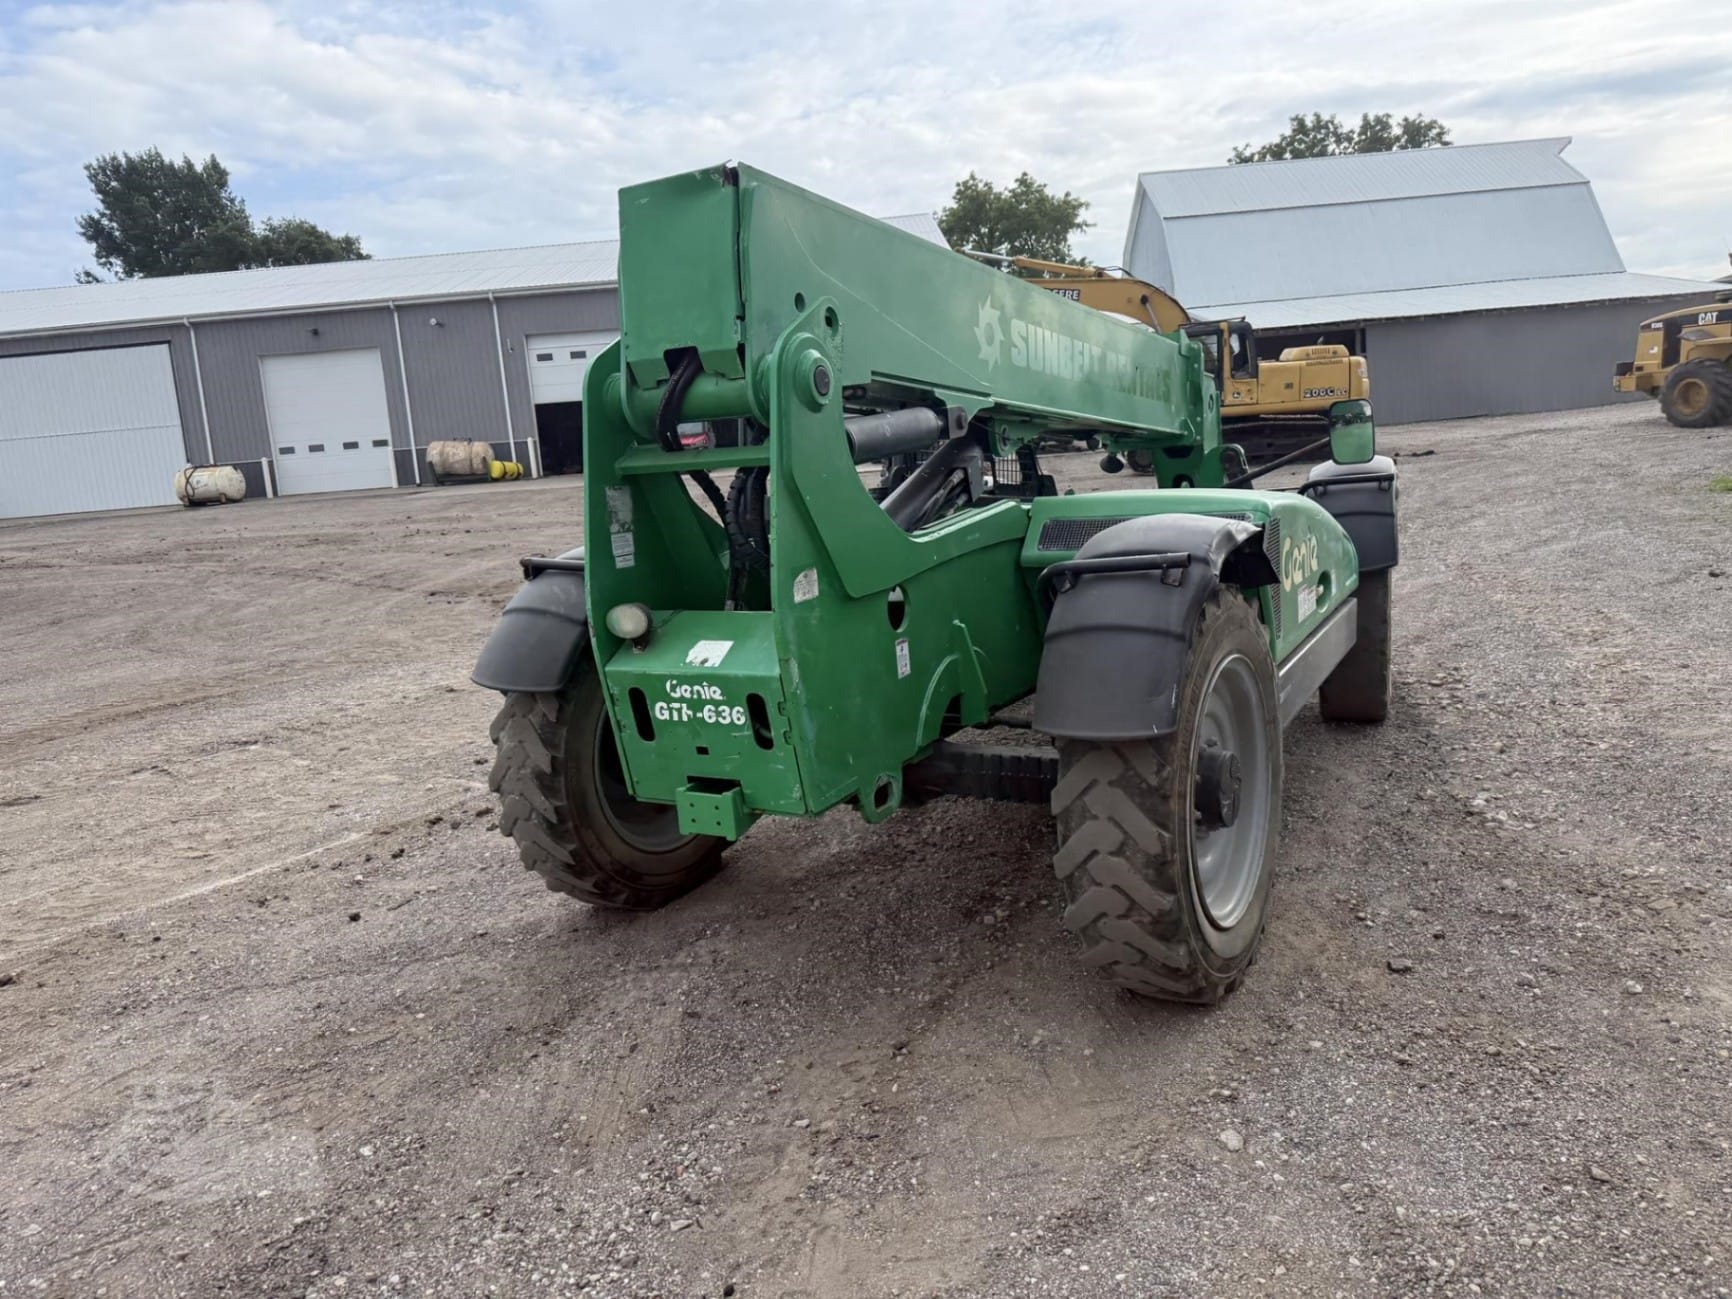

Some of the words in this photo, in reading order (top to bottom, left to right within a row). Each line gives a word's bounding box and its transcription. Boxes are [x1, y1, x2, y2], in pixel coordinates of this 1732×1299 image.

[1698, 312, 1719, 325] CAT
[1010, 318, 1103, 383] SUNBELT
[1282, 535, 1319, 593] Genie
[665, 679, 723, 700] Genie
